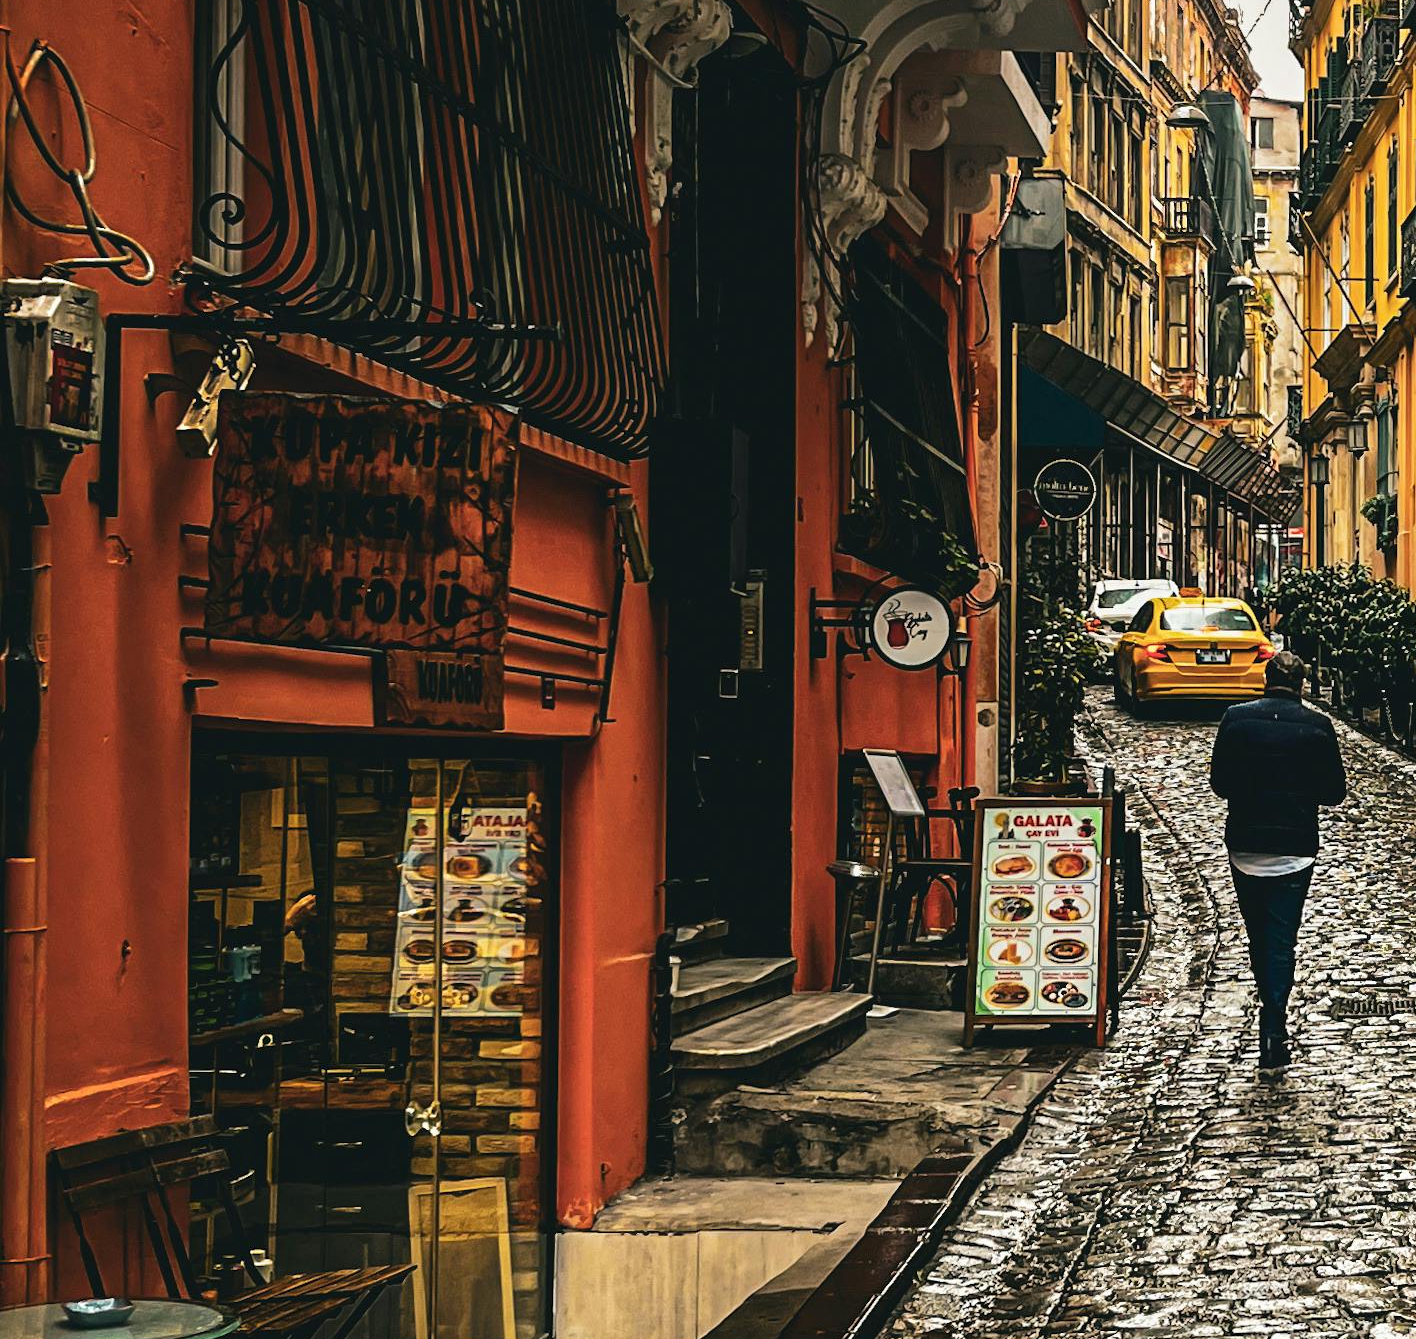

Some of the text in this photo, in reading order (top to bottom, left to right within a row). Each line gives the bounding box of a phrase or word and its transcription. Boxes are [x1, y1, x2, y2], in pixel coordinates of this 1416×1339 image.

[244, 566, 461, 627] KUAFÖRÜ
[1013, 814, 1073, 827] GALATA
[1025, 829, 1042, 838] ÇAY
